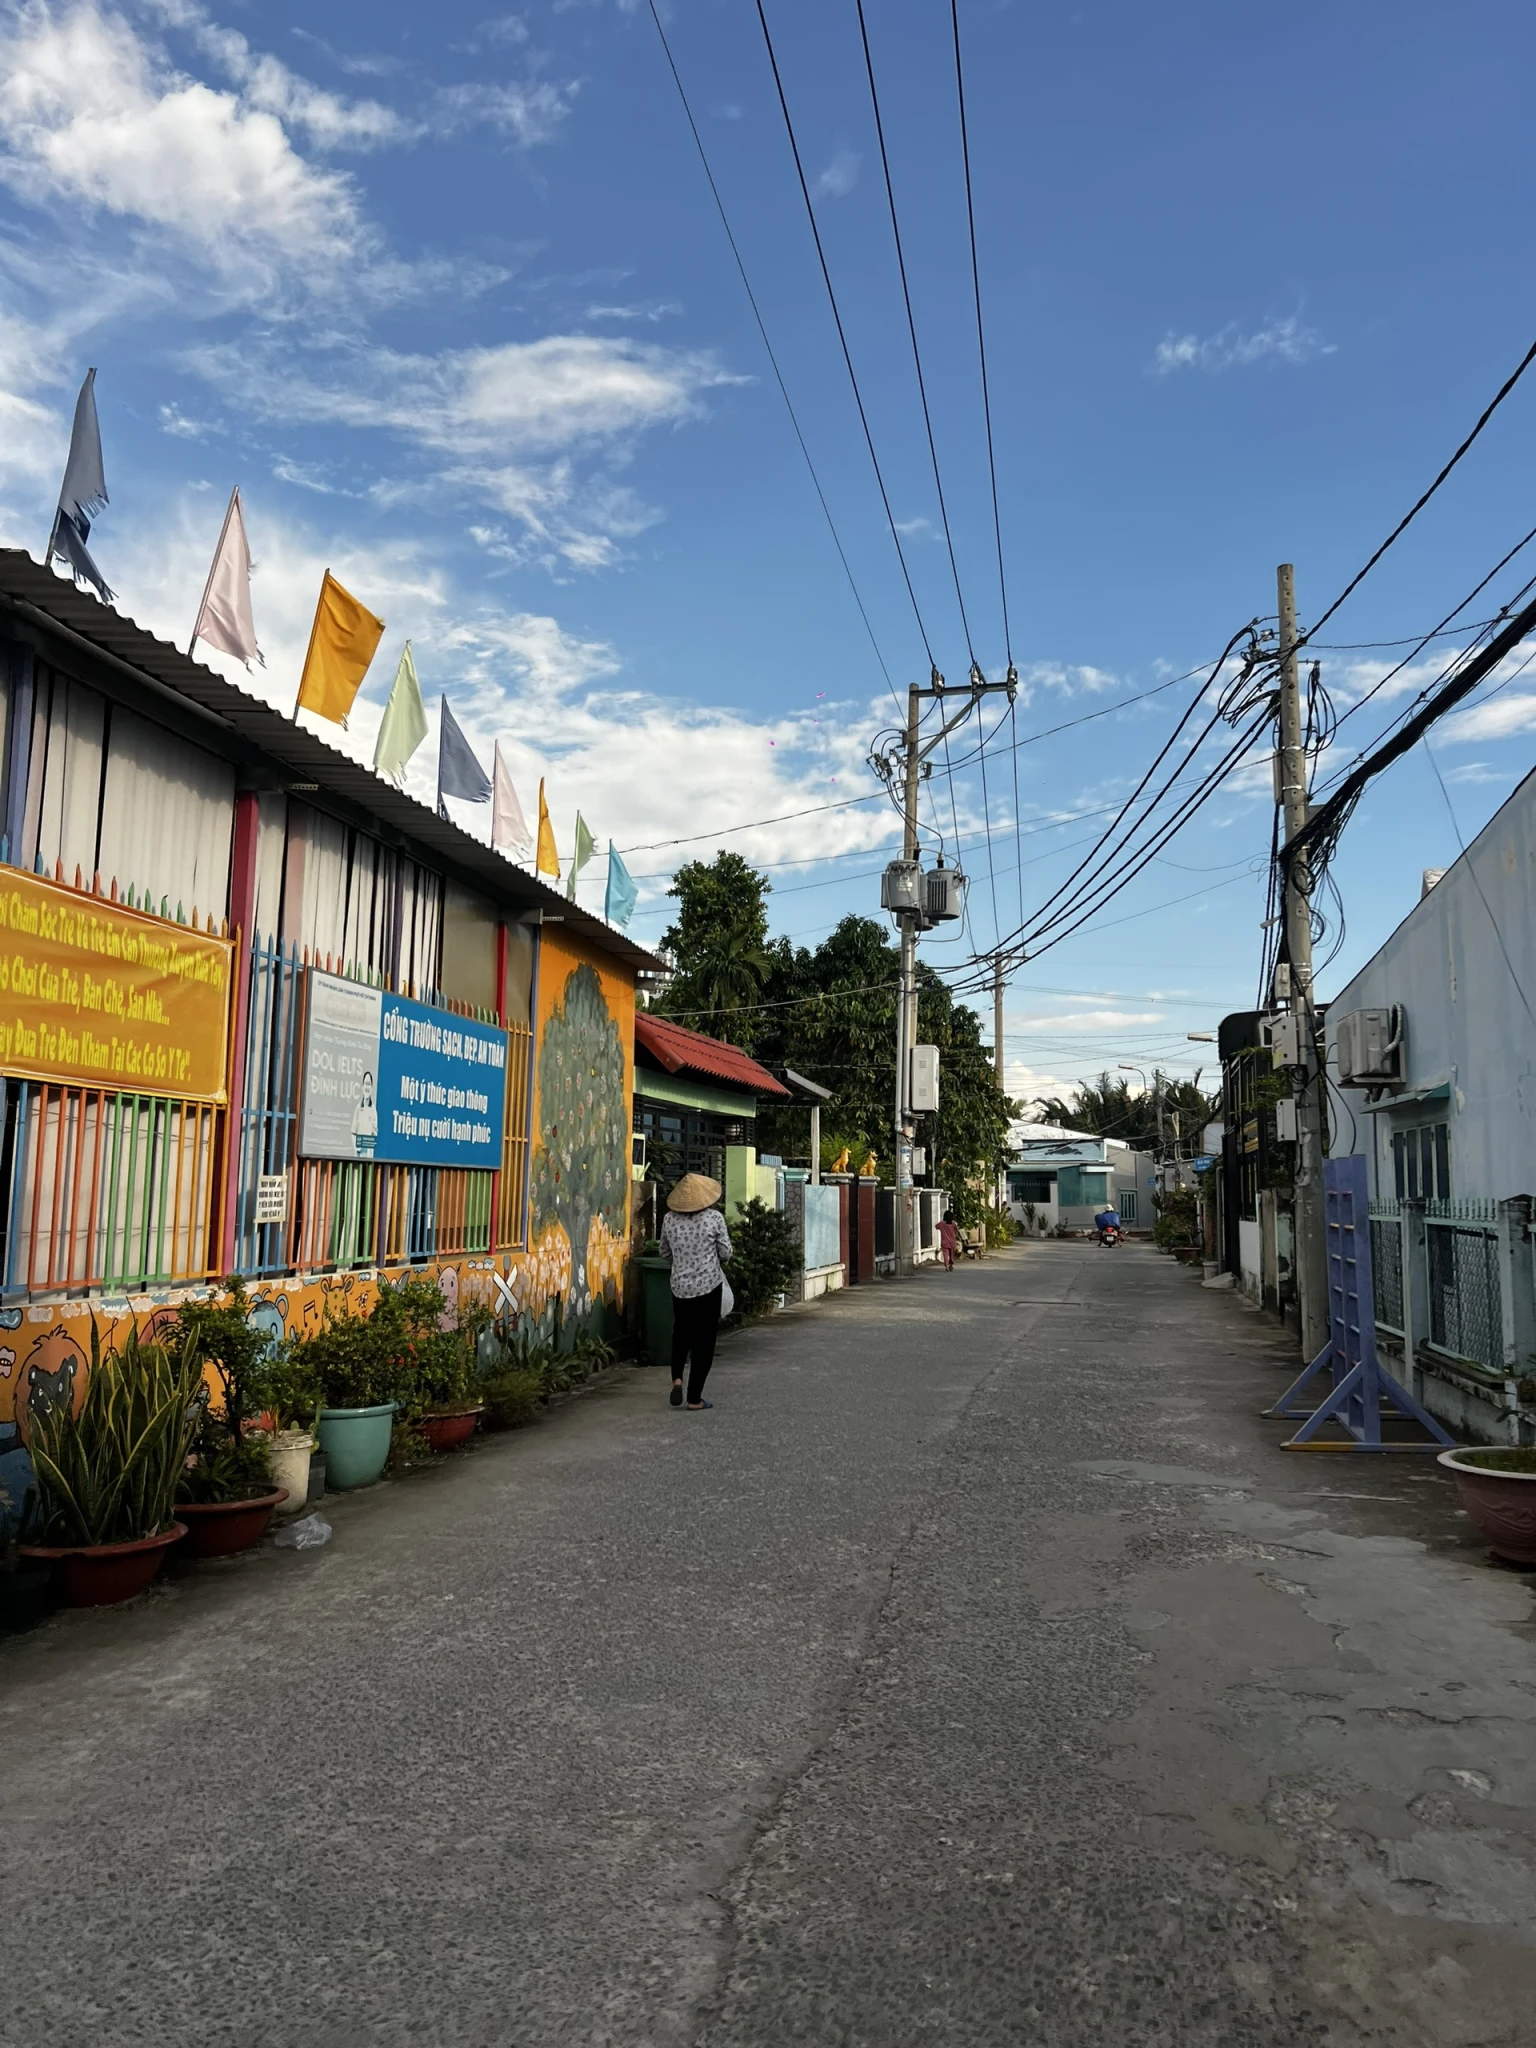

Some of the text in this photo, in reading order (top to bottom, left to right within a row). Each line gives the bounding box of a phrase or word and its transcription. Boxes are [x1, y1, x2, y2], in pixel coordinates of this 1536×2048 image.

[12, 954, 38, 997] Chơi
[383, 1006, 408, 1044] CỔNG
[410, 1018, 441, 1053] TRƯỜNG
[442, 1028, 463, 1061] SẠCH,
[477, 1039, 488, 1064] AN
[488, 1039, 505, 1068] TOÀN
[168, 1047, 176, 1079] Y
[312, 1049, 364, 1077] DOL IELTS
[311, 1071, 338, 1097] ĐÌNH
[401, 1075, 488, 1115] Một ý thức giao thông
[392, 1110, 491, 1146] Triệu nụ cười hạnh phúc
